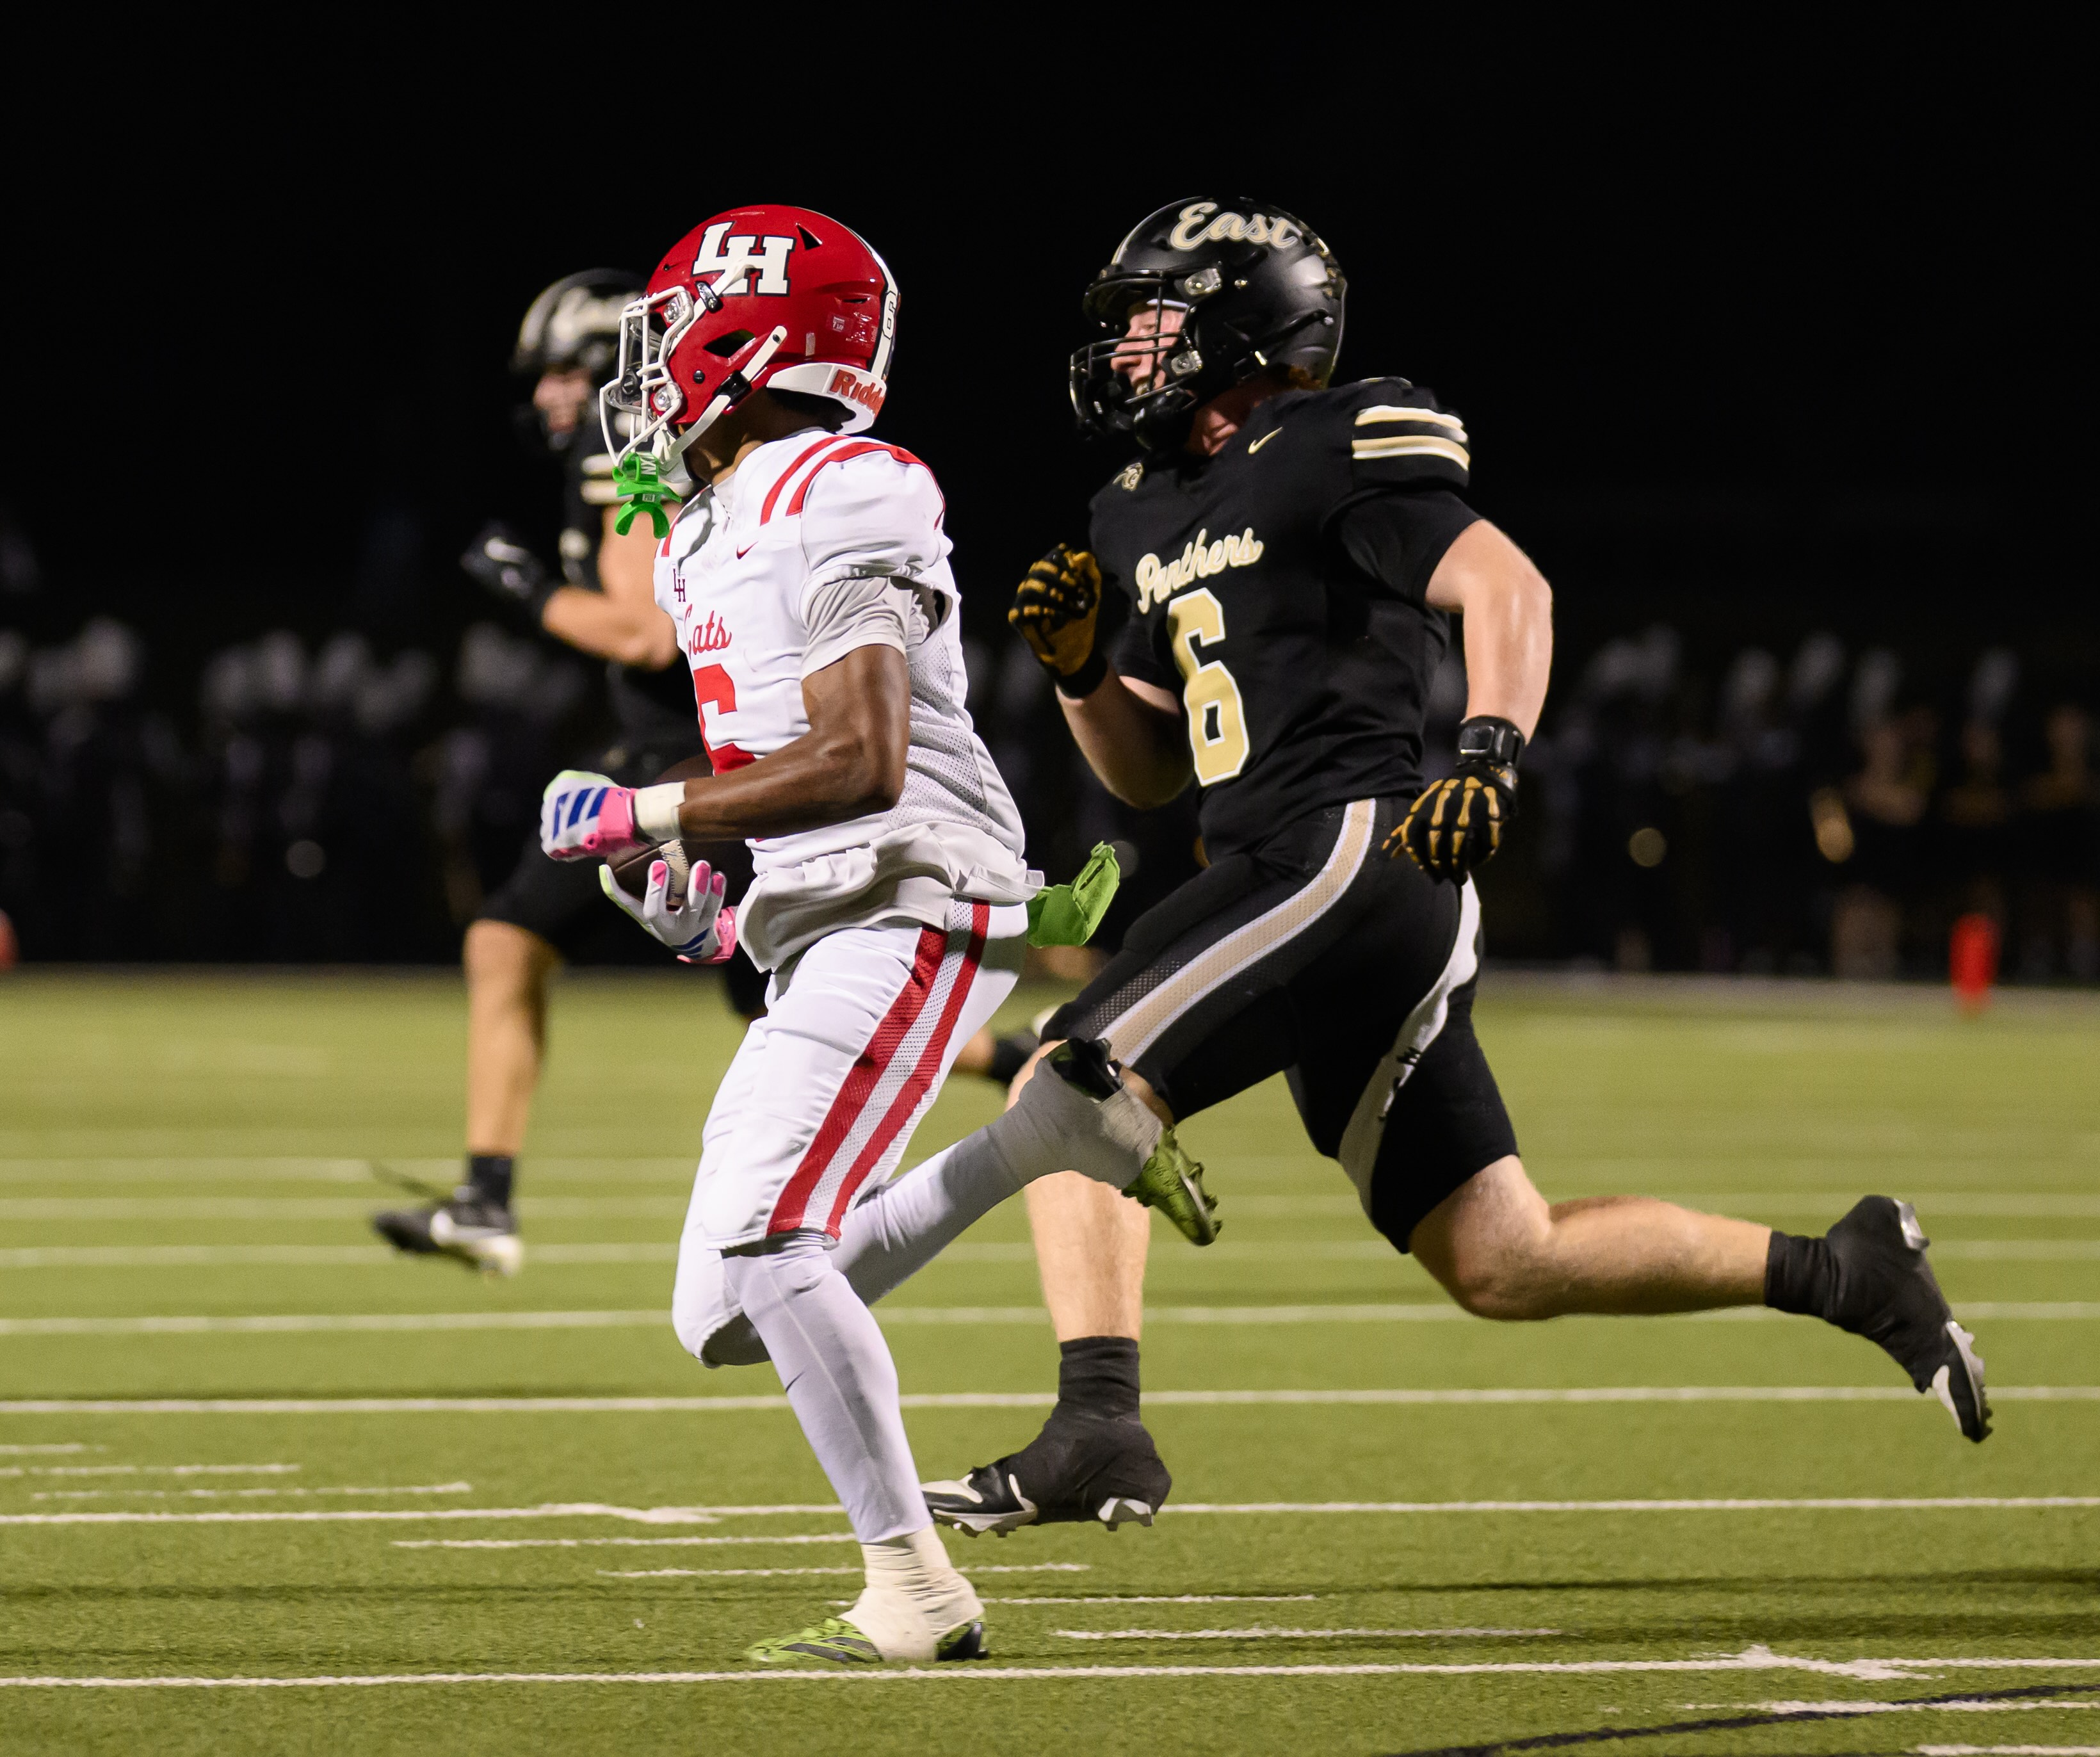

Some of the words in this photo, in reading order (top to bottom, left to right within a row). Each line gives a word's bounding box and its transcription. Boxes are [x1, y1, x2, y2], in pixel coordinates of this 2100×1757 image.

[1170, 202, 1303, 250] East
[691, 221, 796, 297] LH
[883, 291, 897, 339] 6
[830, 369, 885, 419] Ridd
[1136, 528, 1264, 613] Panthers
[1167, 587, 1250, 787] 6
